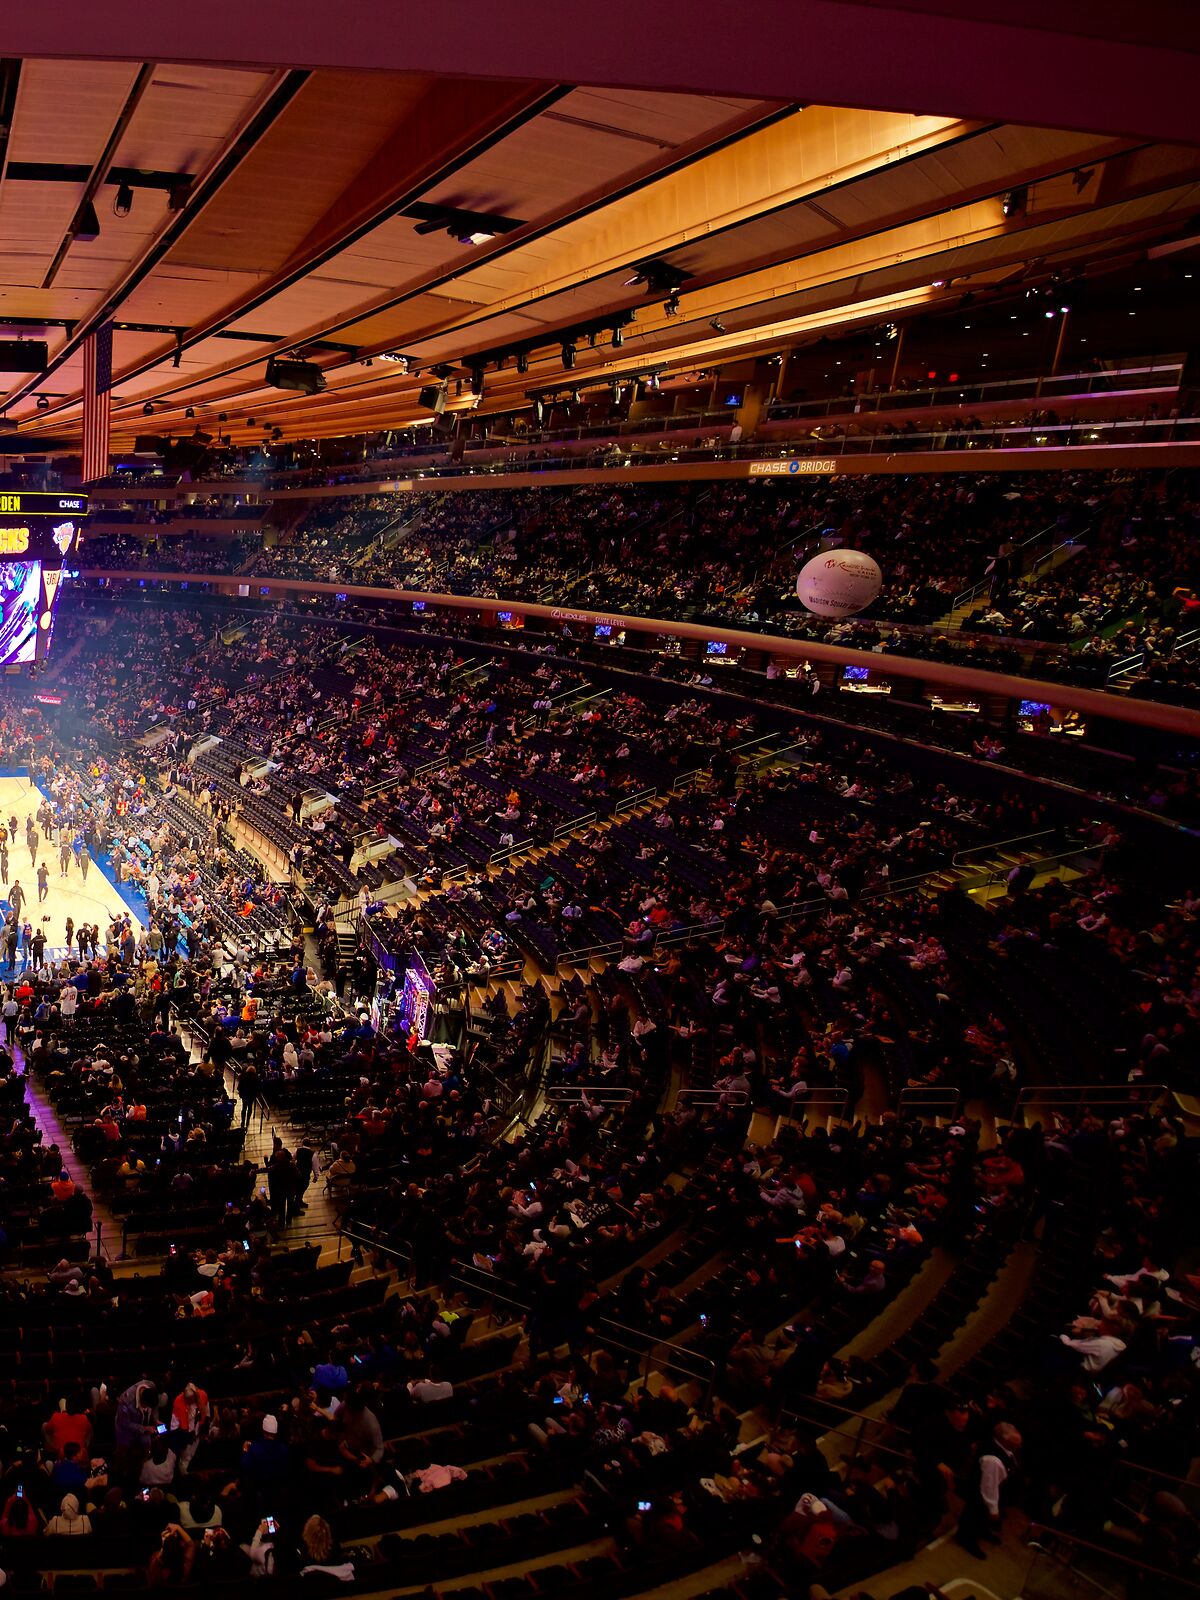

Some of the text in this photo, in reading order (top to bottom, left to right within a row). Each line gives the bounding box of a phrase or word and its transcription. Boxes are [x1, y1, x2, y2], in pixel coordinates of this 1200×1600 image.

[750, 460, 836, 473] CHASE BRIDGE
[59, 499, 80, 509] CHASE
[594, 616, 610, 625] SUITE
[610, 619, 626, 628] LEVEL
